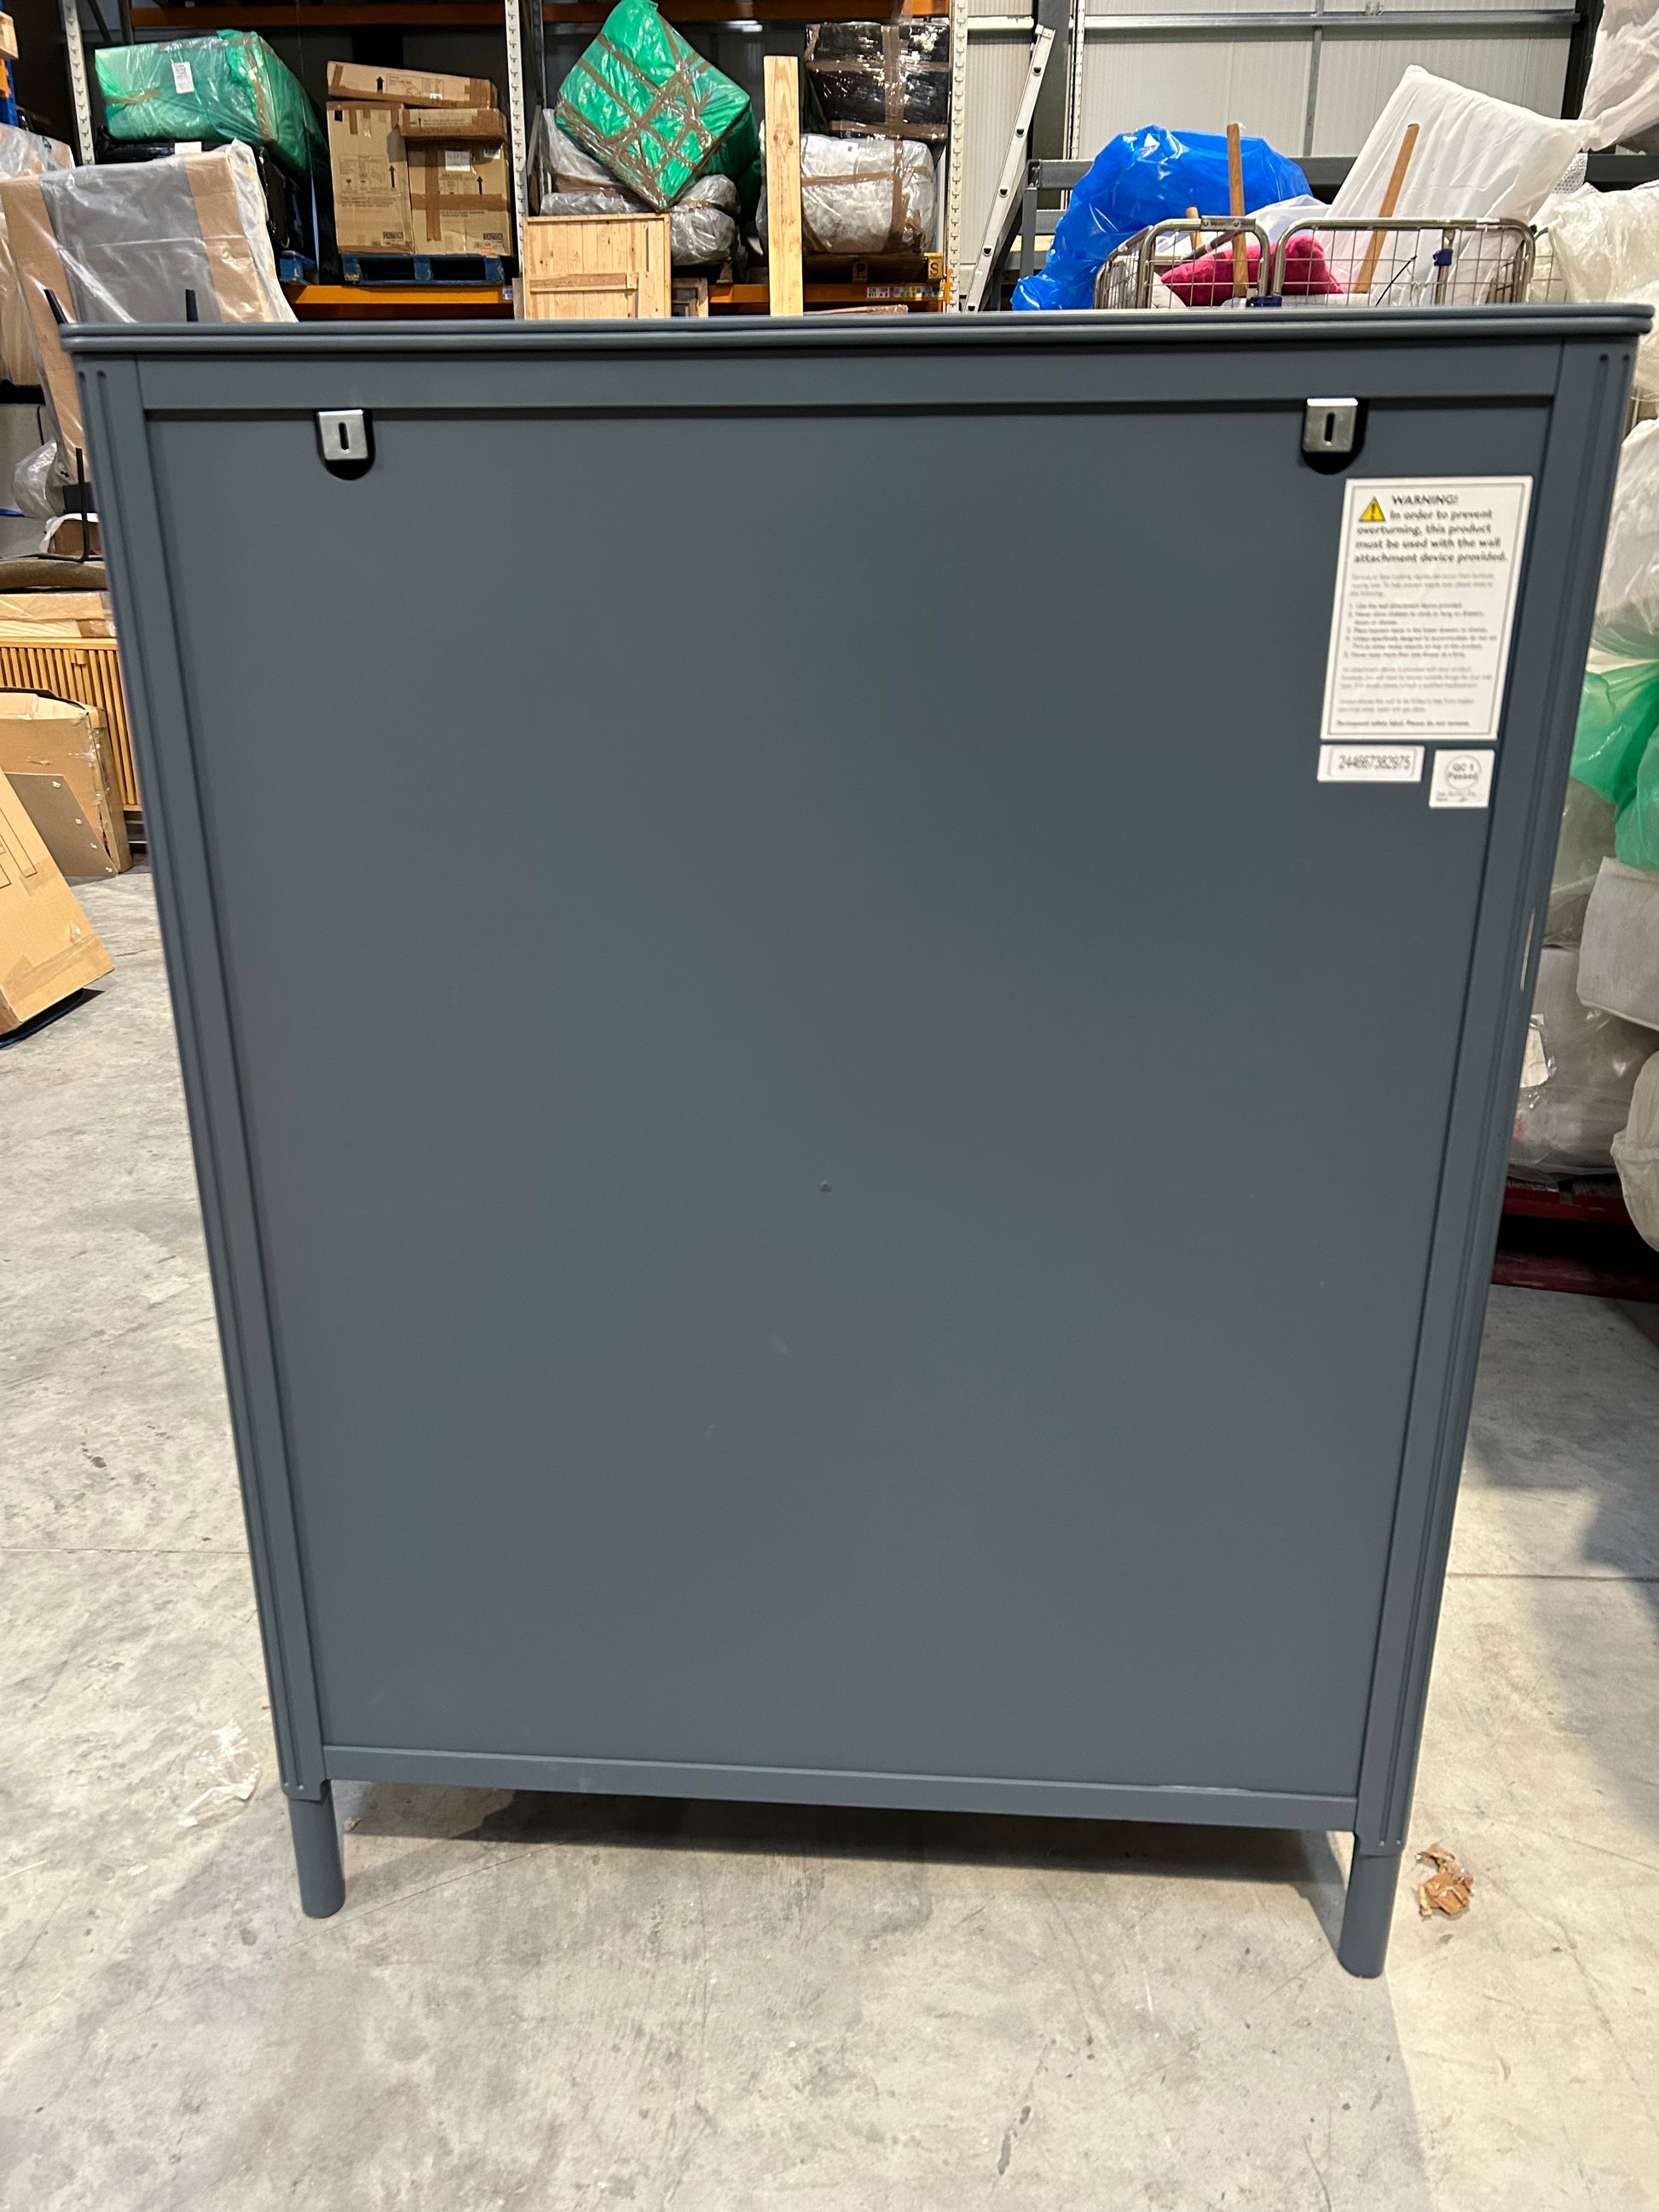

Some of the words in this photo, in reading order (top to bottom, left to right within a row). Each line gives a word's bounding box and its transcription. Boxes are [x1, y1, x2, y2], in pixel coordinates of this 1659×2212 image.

[930, 262, 939, 275] S
[1391, 494, 1459, 505] WARNING!
[1390, 511, 1401, 519] In
[1403, 511, 1433, 519] order
[1436, 511, 1448, 519] to
[1450, 510, 1493, 521] prevent
[1357, 525, 1422, 536] overturning,
[1425, 524, 1445, 534] this
[1448, 524, 1492, 535] product
[1356, 540, 1383, 548] must
[1386, 539, 1400, 548] be
[1402, 539, 1427, 548] used
[1431, 538, 1455, 547] with
[1457, 538, 1476, 547] the
[1479, 538, 1501, 547] wall
[1354, 552, 1417, 563] attachment
[1419, 552, 1454, 562] device
[1457, 552, 1507, 563] provided.
[1452, 763, 1467, 771] QC
